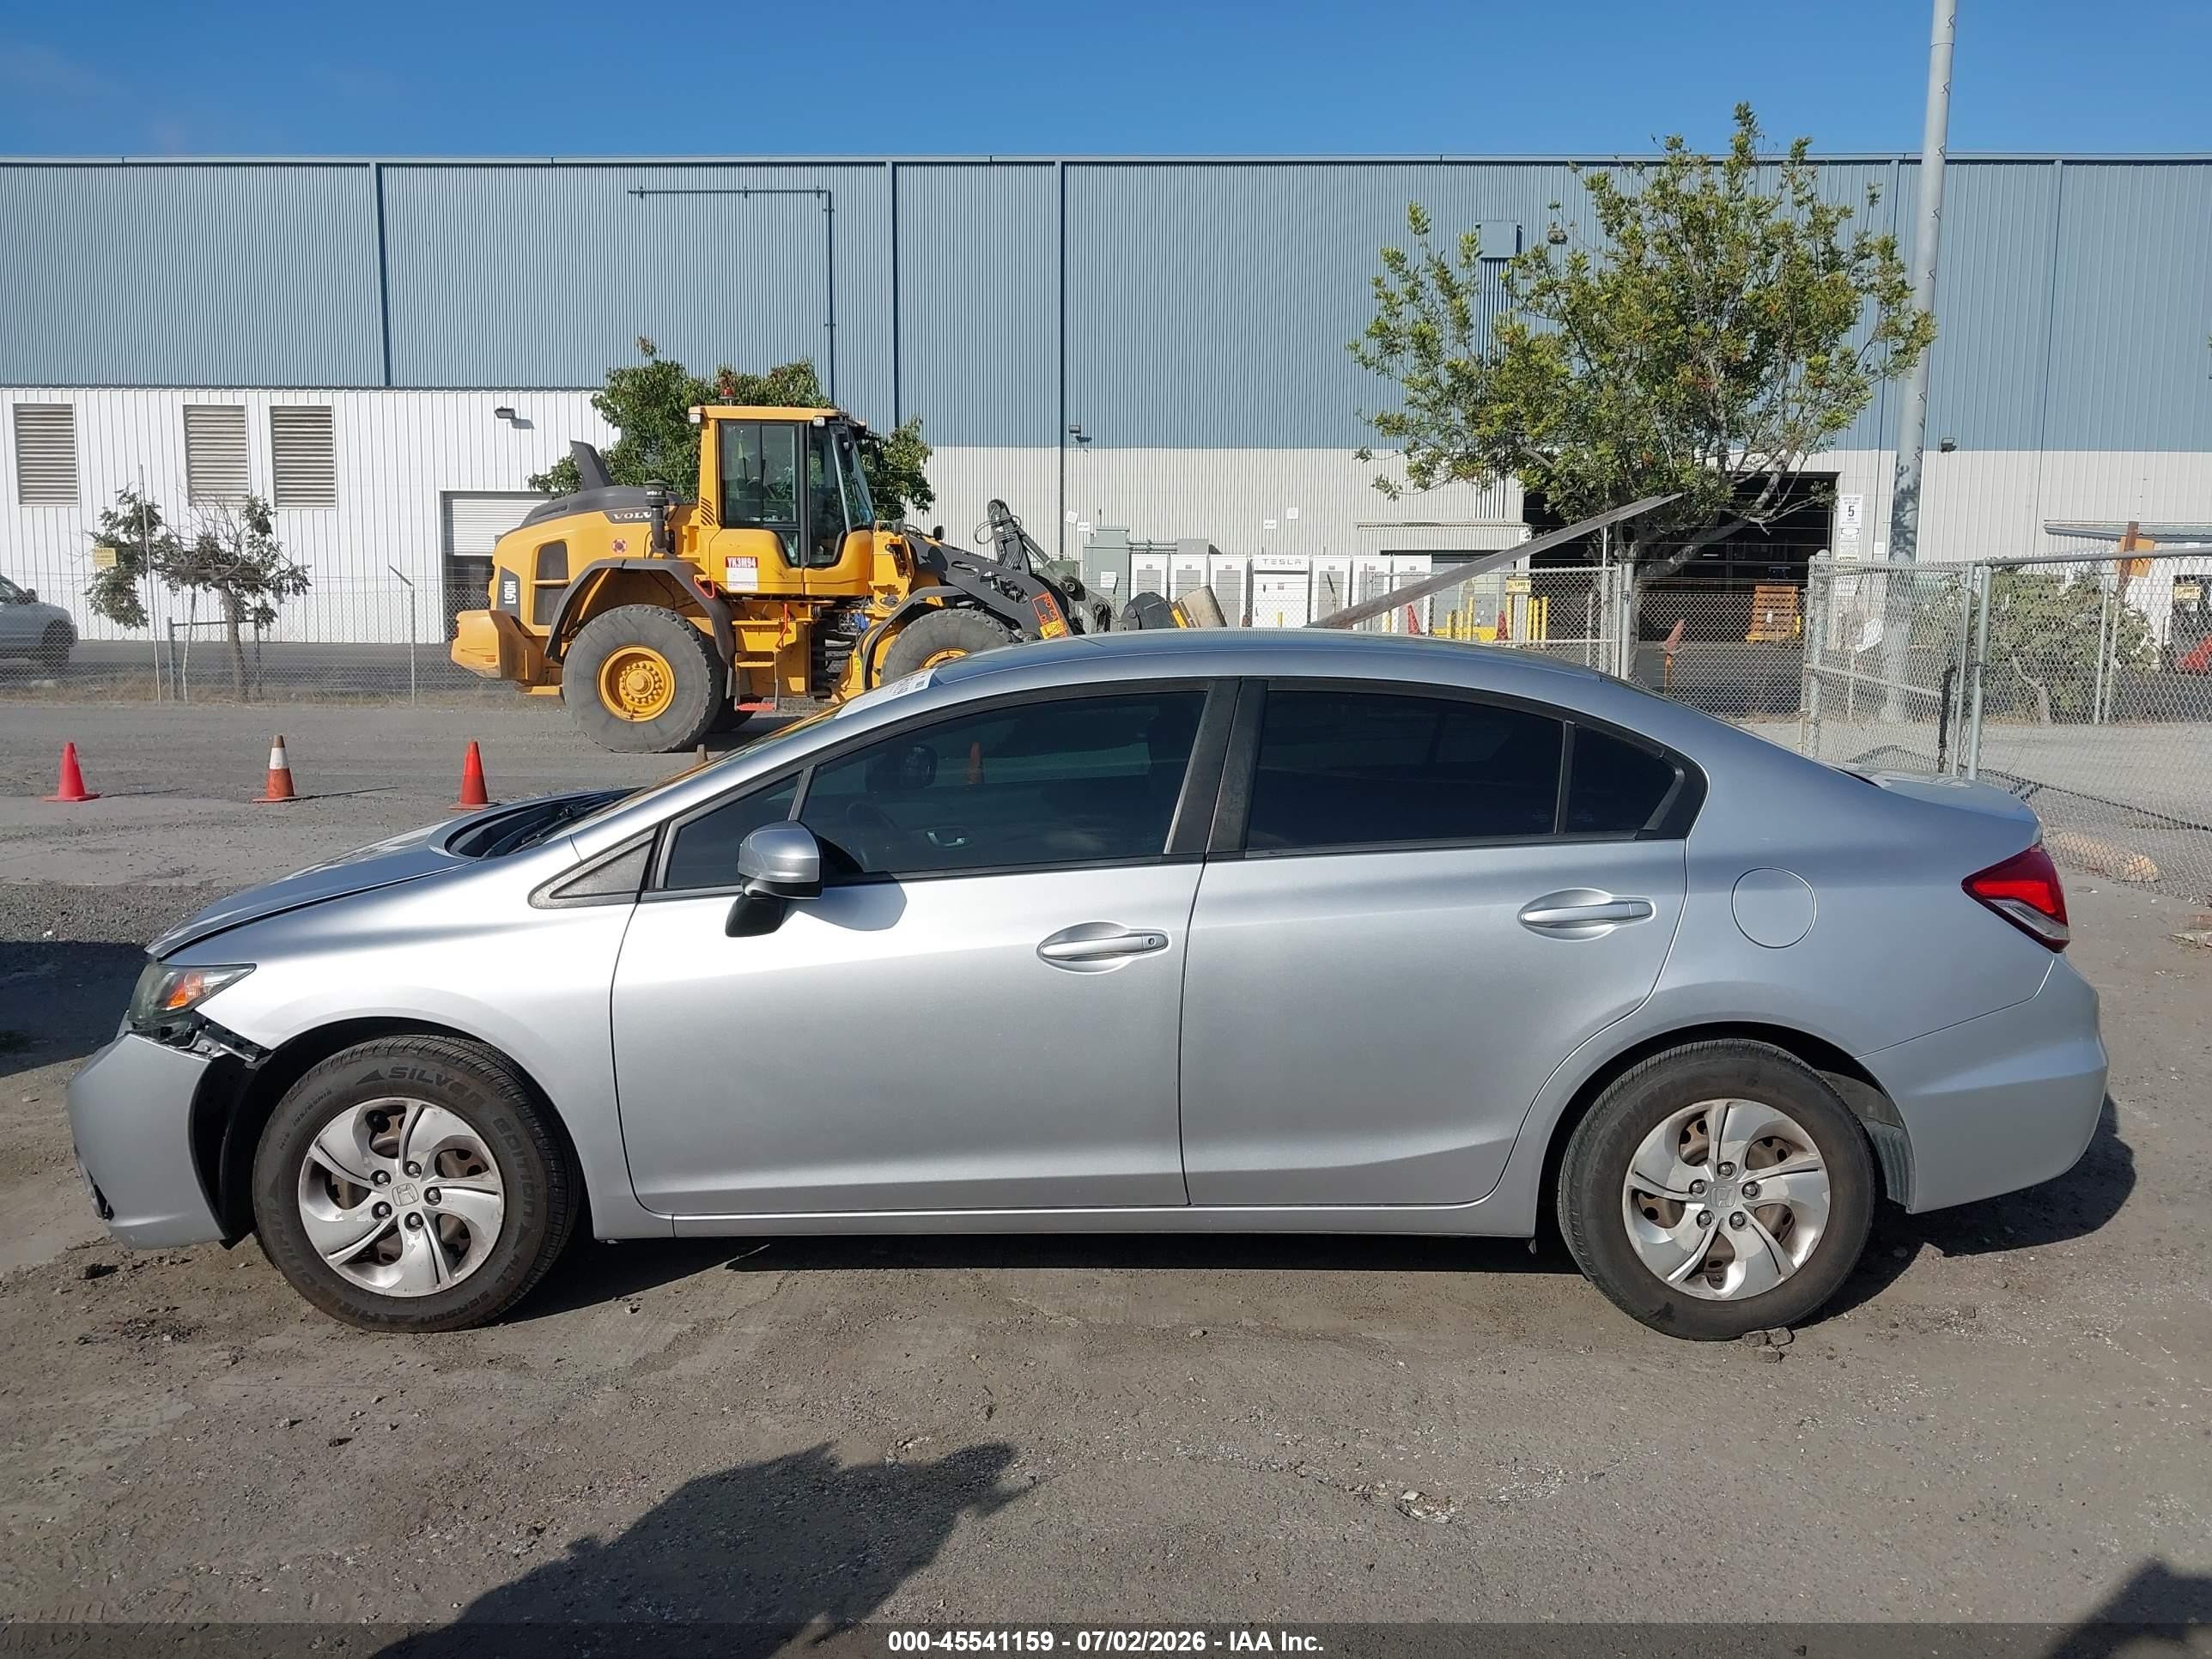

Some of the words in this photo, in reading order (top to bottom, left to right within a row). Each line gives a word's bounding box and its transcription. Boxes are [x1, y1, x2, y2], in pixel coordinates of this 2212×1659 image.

[1848, 505, 1855, 517] 5
[727, 556, 756, 568] YK3M94
[504, 580, 517, 605] L90H
[387, 1066, 489, 1110] SILVER
